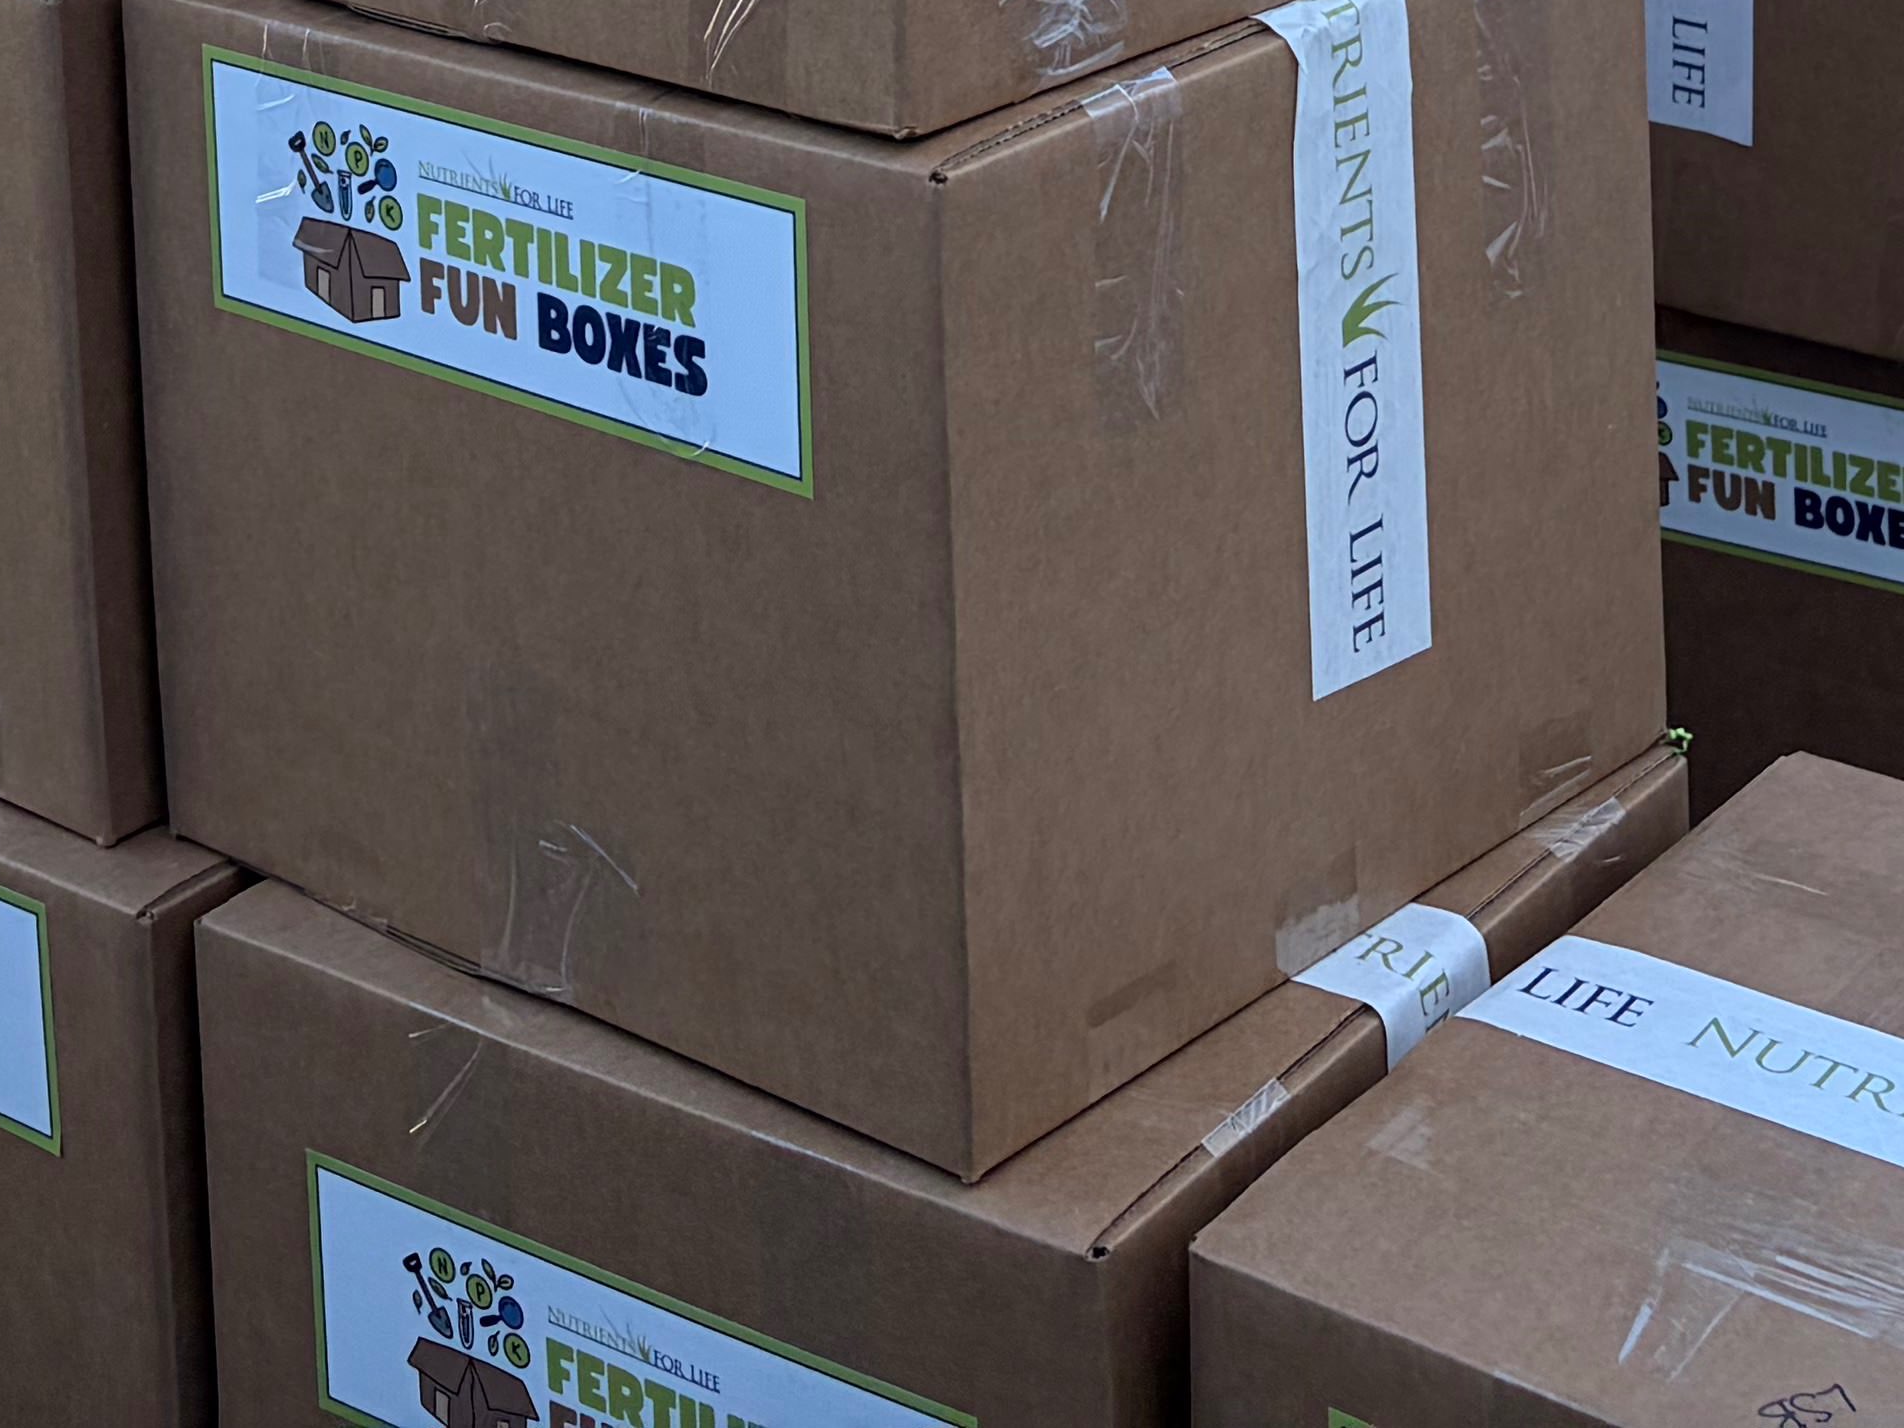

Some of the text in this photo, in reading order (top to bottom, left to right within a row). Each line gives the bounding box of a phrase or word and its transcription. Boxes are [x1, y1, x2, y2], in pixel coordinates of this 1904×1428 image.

[1671, 15, 1709, 109] LIFE
[417, 160, 574, 219] NUTRIENTS FOR LIFE
[416, 193, 696, 328] FERTILIZER
[419, 257, 709, 397] FUN BOXES
[1343, 348, 1379, 507] FOR
[1773, 413, 1799, 432] FOR
[1687, 463, 1776, 521] FUN
[1348, 521, 1387, 655] LIFE
[1516, 965, 1656, 1030] LIFE
[547, 1305, 721, 1394] NUTRIENTS FOR LIFE
